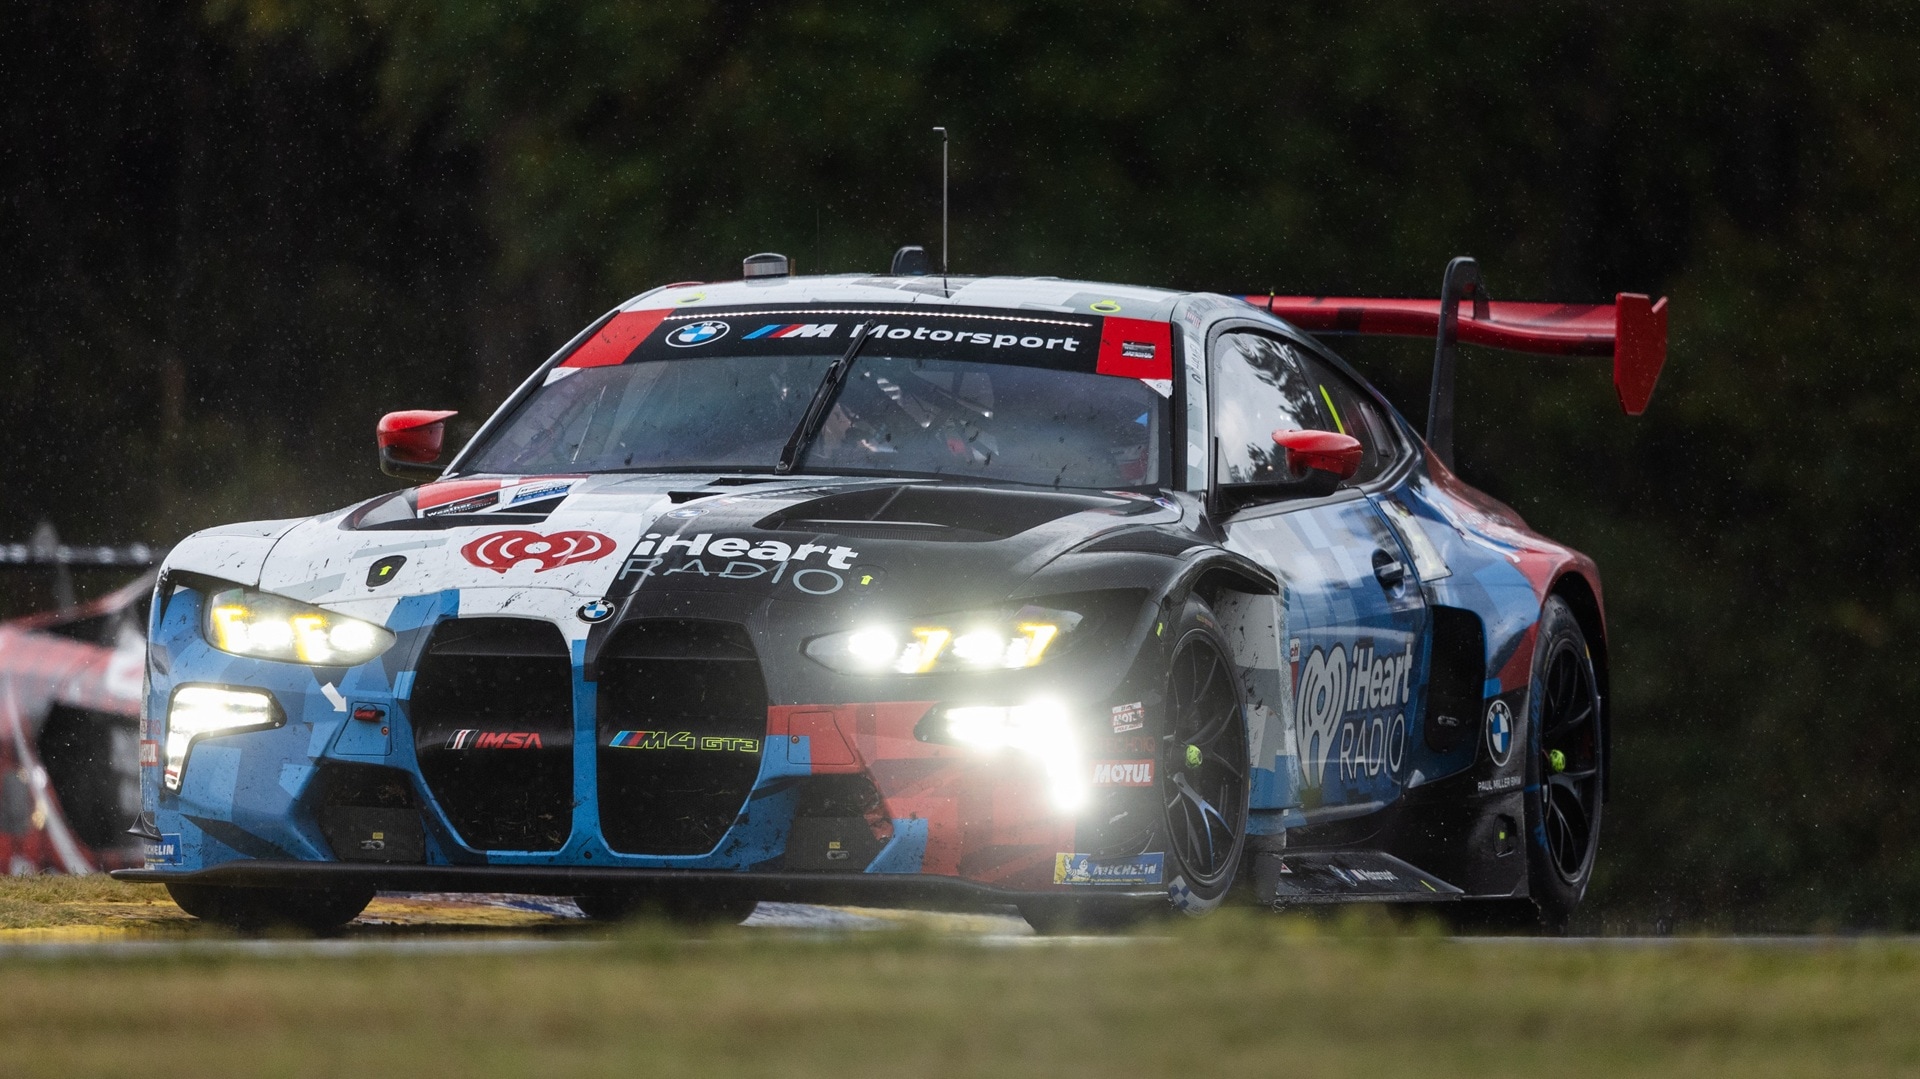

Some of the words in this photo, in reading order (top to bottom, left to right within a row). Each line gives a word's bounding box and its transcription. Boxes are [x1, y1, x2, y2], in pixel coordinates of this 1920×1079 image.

[849, 323, 1080, 352] Motorsport
[632, 533, 859, 570] iHeart
[618, 558, 844, 595] RADIO
[1346, 643, 1412, 712] iHeart
[475, 732, 543, 749] IMSA
[701, 736, 759, 752] GT3
[1340, 713, 1405, 781] RADIO
[1093, 763, 1151, 783] MOTUL
